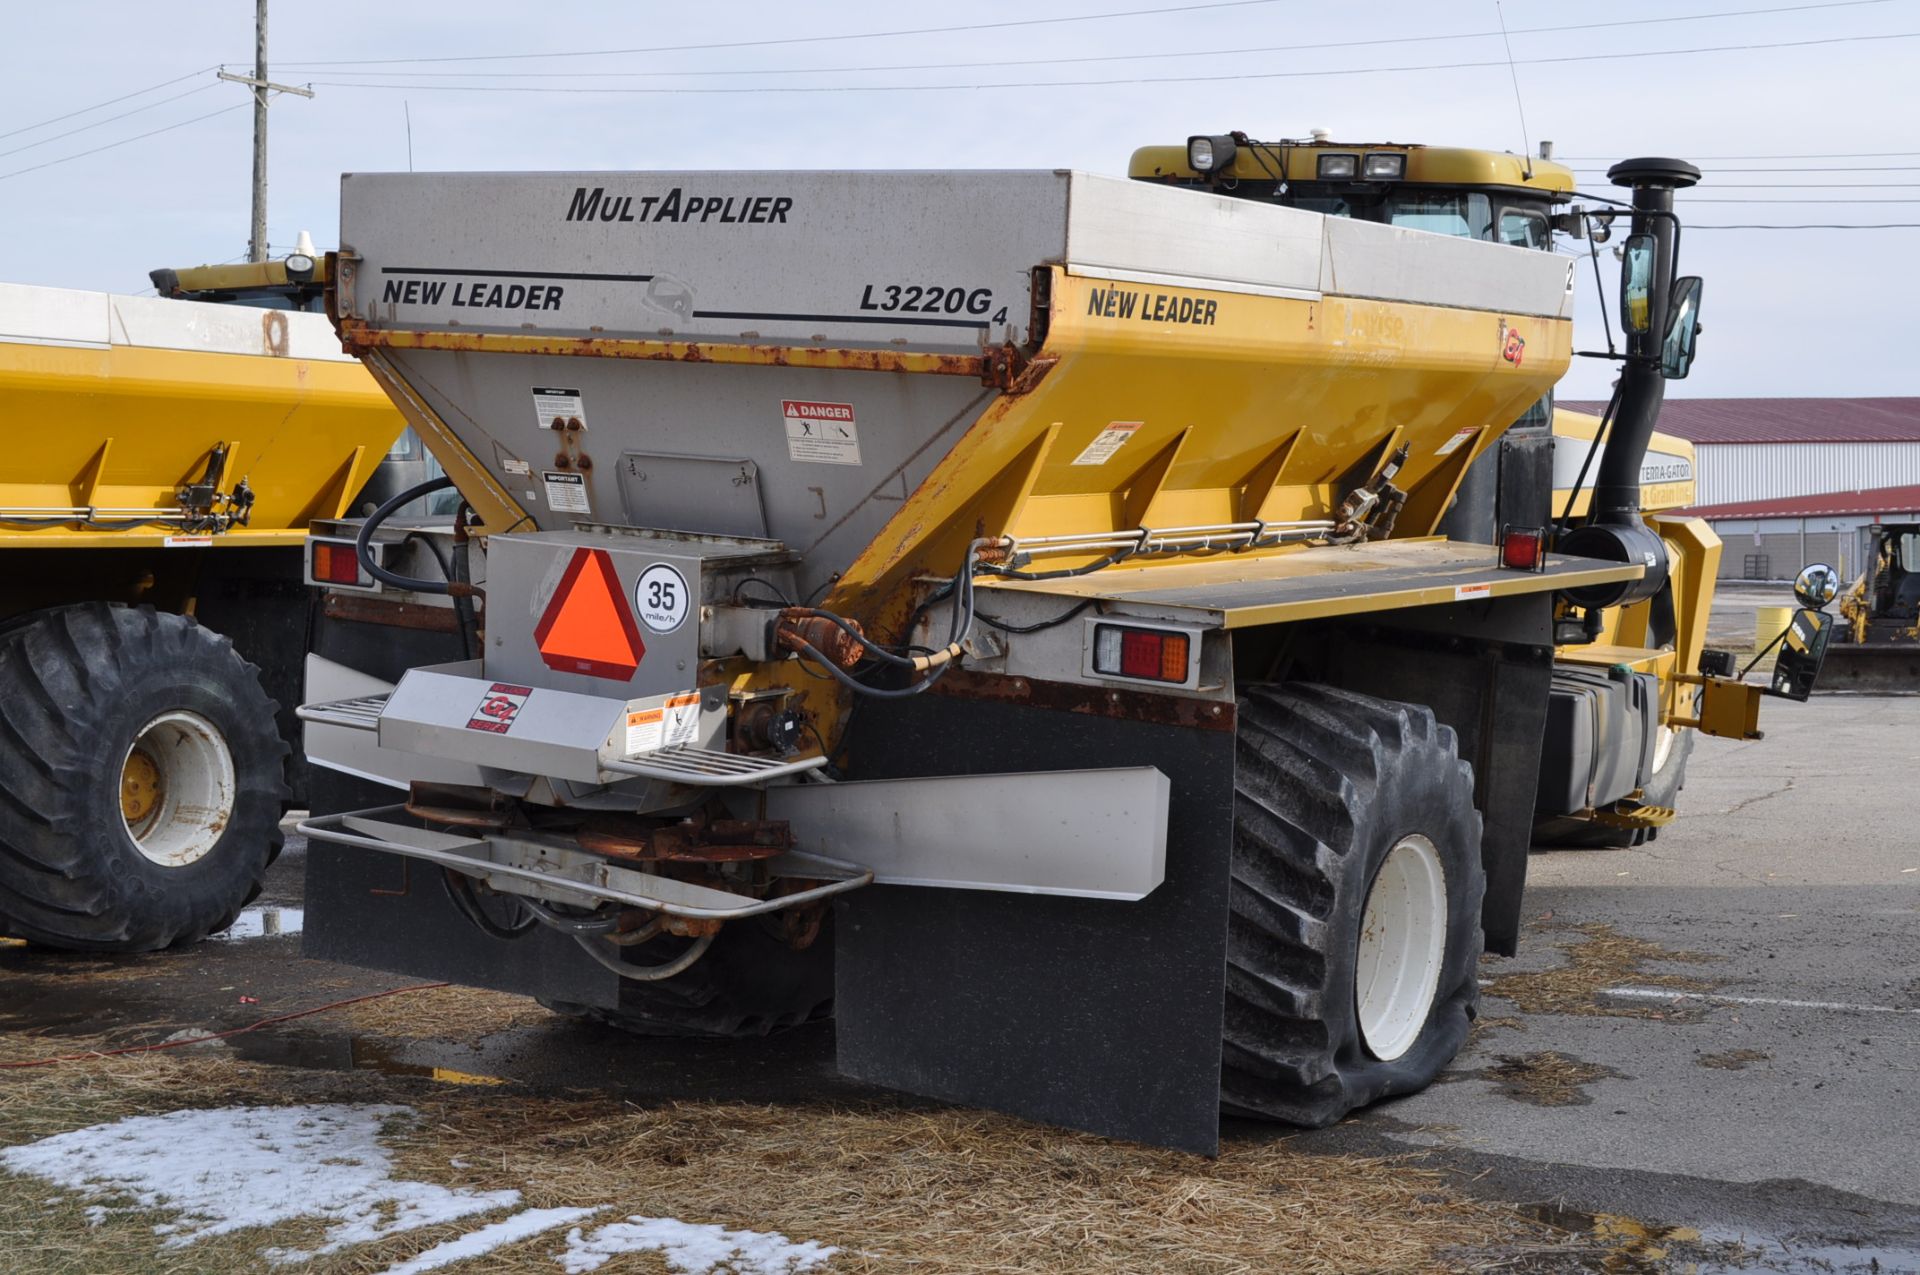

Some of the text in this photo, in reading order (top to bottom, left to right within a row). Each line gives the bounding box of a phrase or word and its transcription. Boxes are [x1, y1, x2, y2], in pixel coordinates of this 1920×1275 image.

[1566, 262, 1573, 290] 2
[383, 280, 564, 310] NEW LEADER
[1087, 288, 1217, 325] NEW LEADER
[800, 405, 851, 418] DANGER
[1641, 463, 1690, 480] TERRA-GATOR
[648, 581, 675, 611] 35
[645, 613, 676, 623] mile/h
